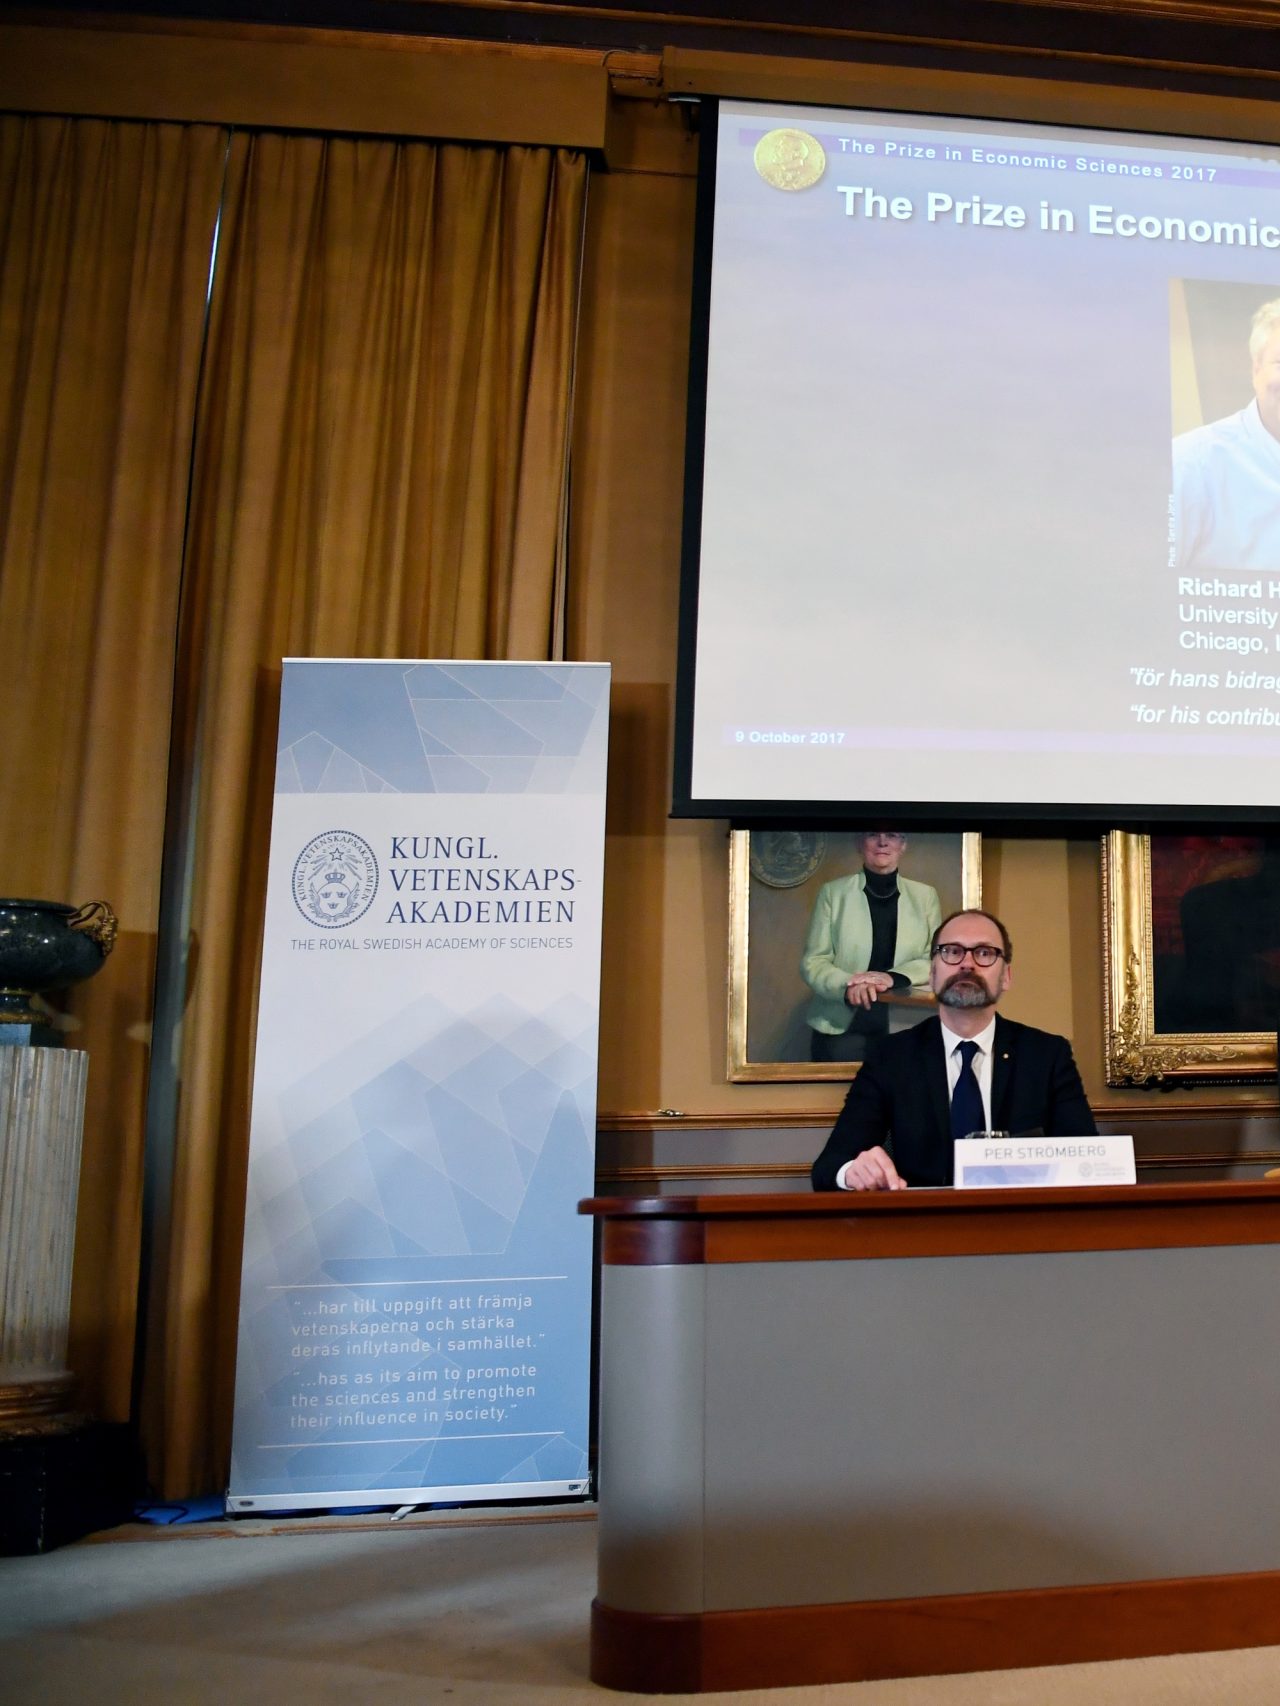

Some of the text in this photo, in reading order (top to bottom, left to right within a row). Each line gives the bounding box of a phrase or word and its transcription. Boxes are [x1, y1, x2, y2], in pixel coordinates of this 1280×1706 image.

[838, 138, 1217, 182] The Prize in Economic Sciences 2017
[837, 185, 913, 220] The
[927, 192, 1026, 228] Prize
[1040, 200, 1074, 232] in
[1088, 204, 1280, 249] Economic
[1178, 577, 1262, 599] Richard
[1179, 603, 1279, 629] University
[1179, 630, 1269, 655] Chicago,
[1169, 669, 1220, 689] hans
[1170, 705, 1200, 725] his
[735, 730, 846, 744] 9 October 2017
[390, 836, 499, 859] KUNGL.
[301, 835, 375, 901] VETENSKAPSAKADEMIEN
[388, 868, 583, 892] VETENSKAPS-
[386, 900, 576, 924] AKADEMIEN
[291, 937, 573, 951] THE ROYAL SWEDISH ACADEMY OF SCIENCES
[984, 1147, 1013, 1160] PER
[353, 1298, 378, 1313] till
[383, 1296, 443, 1316] uppgift
[448, 1296, 472, 1310] att
[477, 1294, 533, 1311] främja
[291, 1316, 516, 1337] vetenskaperna och stärka
[291, 1343, 340, 1358] deras
[346, 1339, 431, 1358] inflytande
[436, 1337, 442, 1352] i
[354, 1371, 374, 1385] as
[379, 1369, 401, 1383] its
[406, 1367, 438, 1382] aim
[444, 1367, 460, 1381] to
[466, 1364, 538, 1383] promote
[291, 1385, 536, 1408] the sciences and strengthen
[290, 1414, 332, 1429] their
[338, 1410, 417, 1426] influence
[423, 1407, 439, 1423] in
